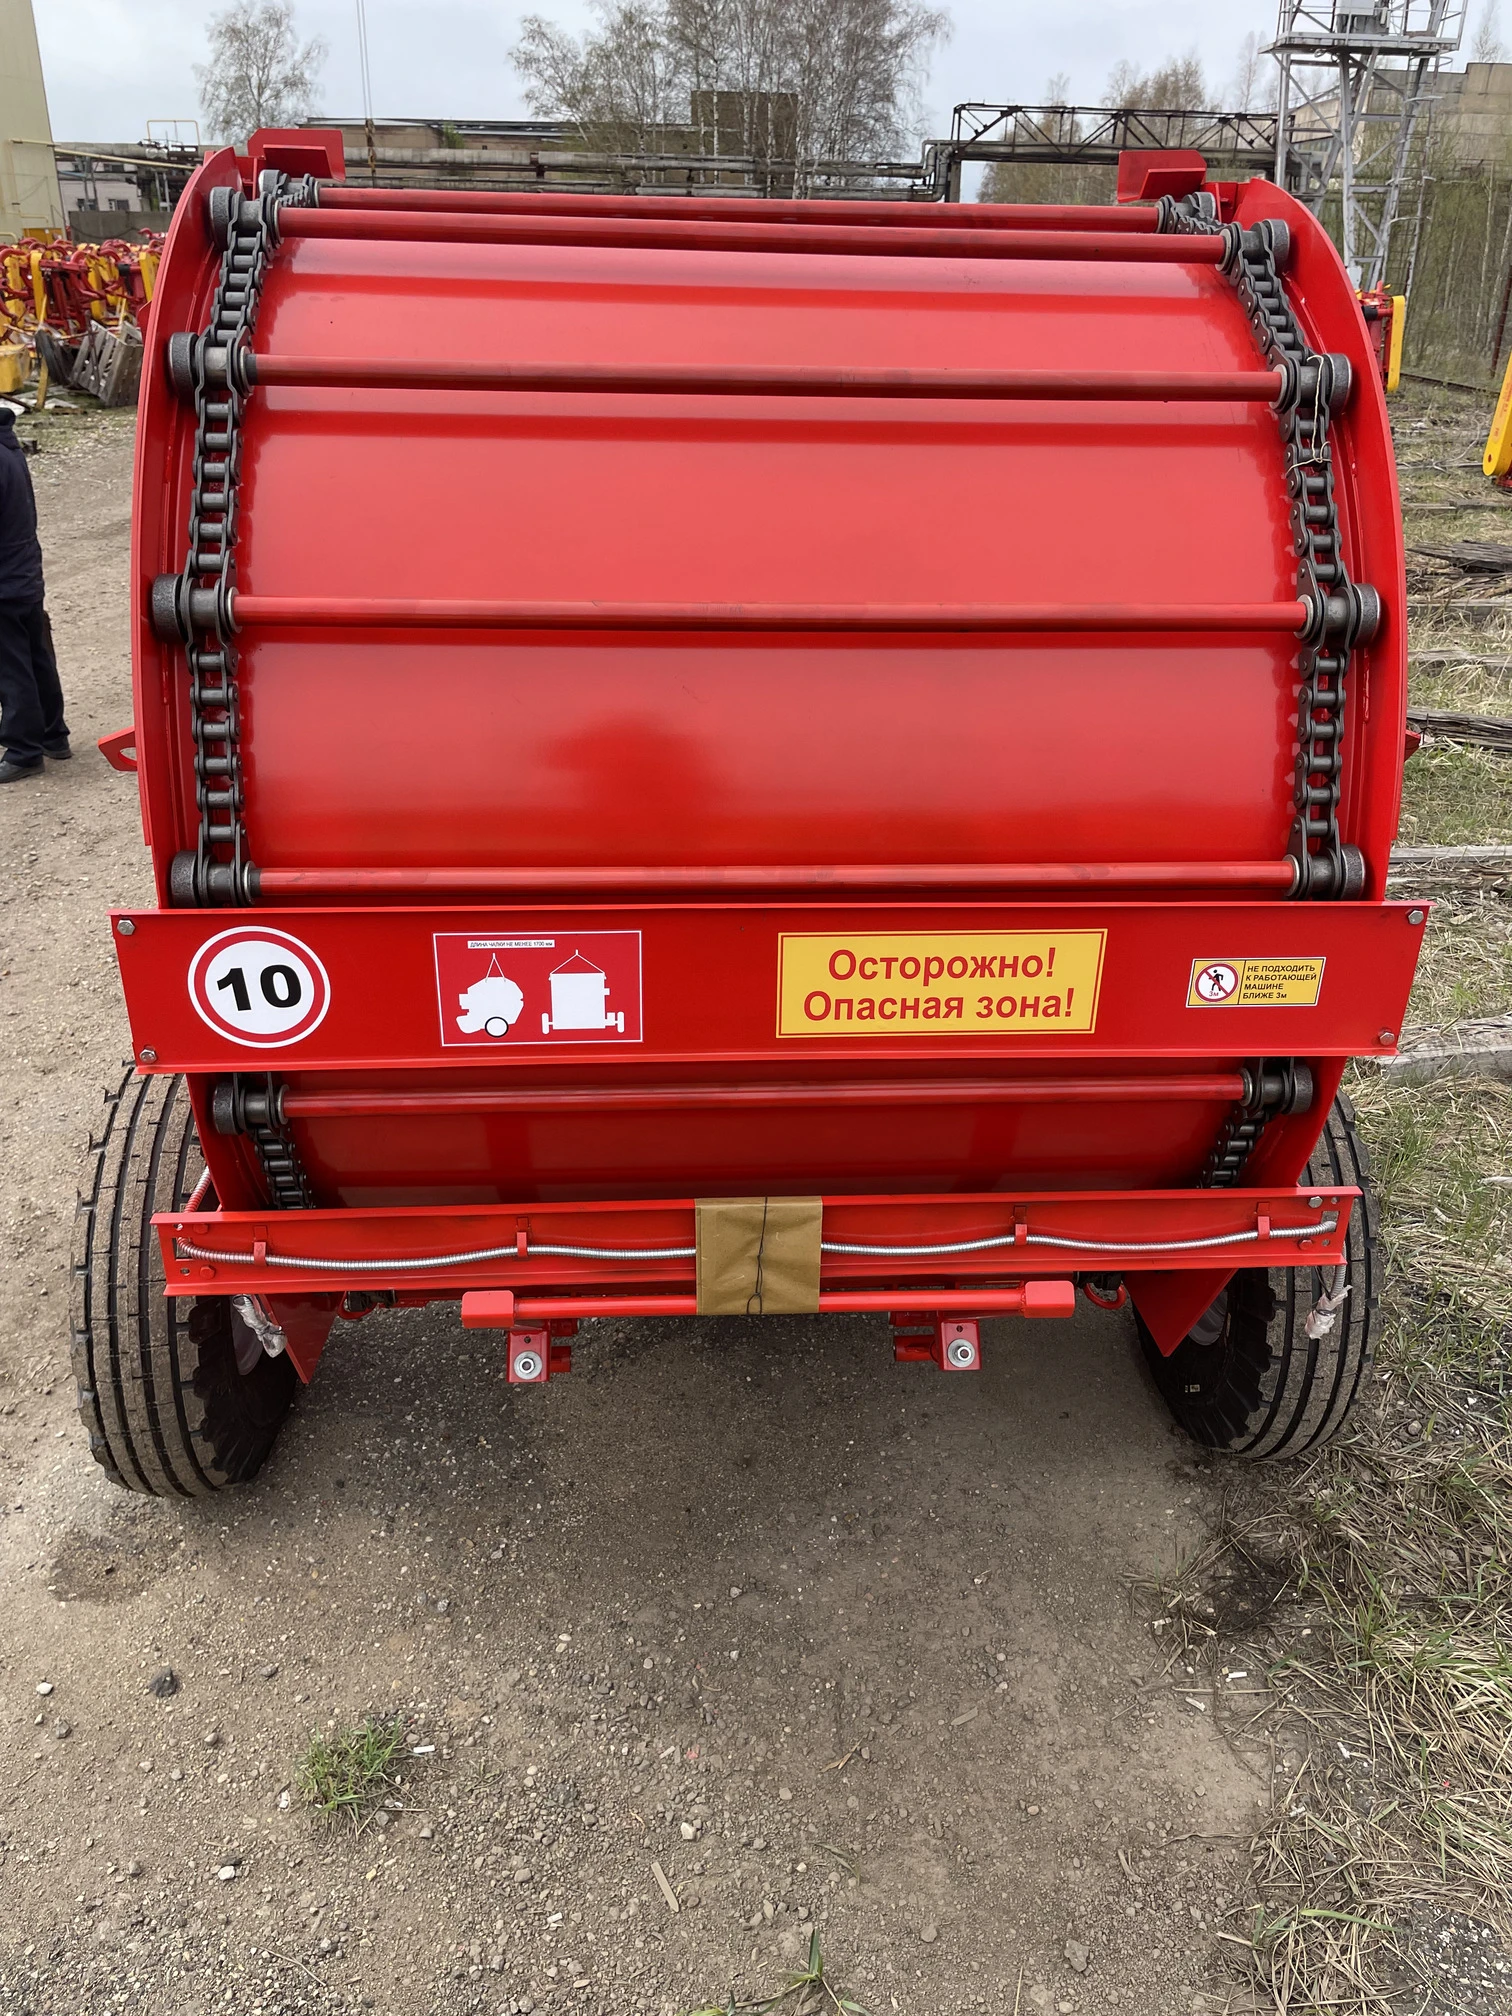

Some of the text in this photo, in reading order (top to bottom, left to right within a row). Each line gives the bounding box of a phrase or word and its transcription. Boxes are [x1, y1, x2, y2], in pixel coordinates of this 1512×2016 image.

[829, 947, 1056, 986] Осторожно!
[1253, 973, 1317, 981] РАБОТАЮЩЕЙ
[1261, 965, 1315, 973] ПОДХОДИТЬ
[217, 964, 301, 1011] 10
[804, 988, 1074, 1021] Опасная зона!
